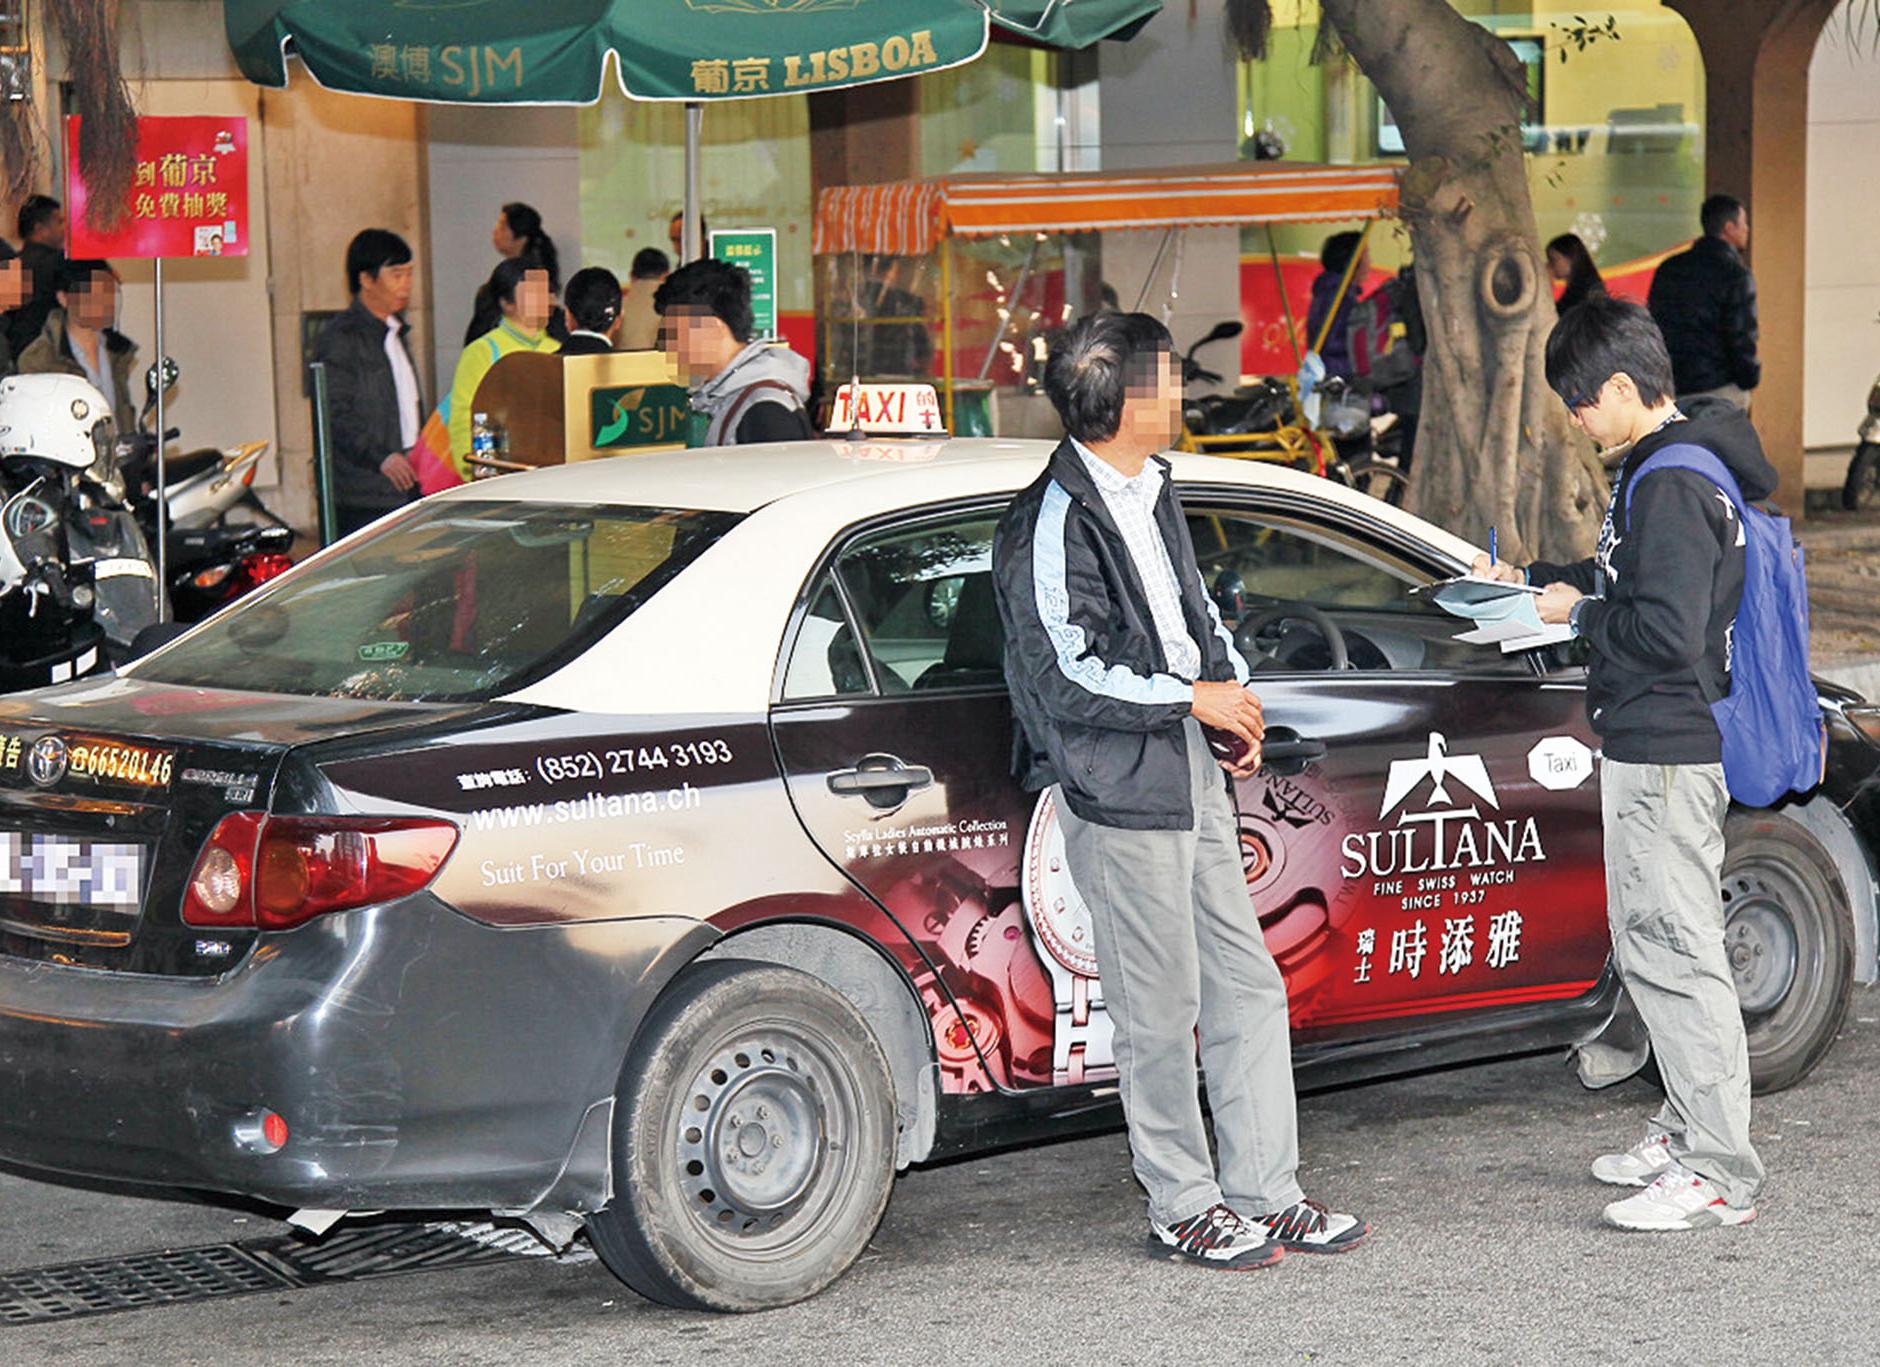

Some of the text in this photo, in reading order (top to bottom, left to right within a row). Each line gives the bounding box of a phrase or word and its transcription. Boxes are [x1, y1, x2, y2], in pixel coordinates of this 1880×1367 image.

[440, 46, 523, 97] SJM
[690, 30, 938, 93] 葡京 LISBOA
[838, 390, 906, 424] TAXI
[87, 746, 173, 785] 66520146
[536, 751, 604, 784] (852)
[605, 747, 668, 775] 2744
[670, 739, 733, 768] 3193
[1543, 751, 1578, 774] Taxi
[472, 782, 701, 832] www.sultana.ch
[958, 818, 1008, 834] Collection
[1340, 803, 1547, 879] SULTANA
[480, 843, 685, 887] Suit For Your Time
[1373, 880, 1404, 896] FINE
[1417, 875, 1456, 892] SWISS
[1470, 869, 1515, 888] WATCH
[1401, 889, 1486, 911] SINCE 1937
[1353, 909, 1523, 984] 瑞士 時添雅
